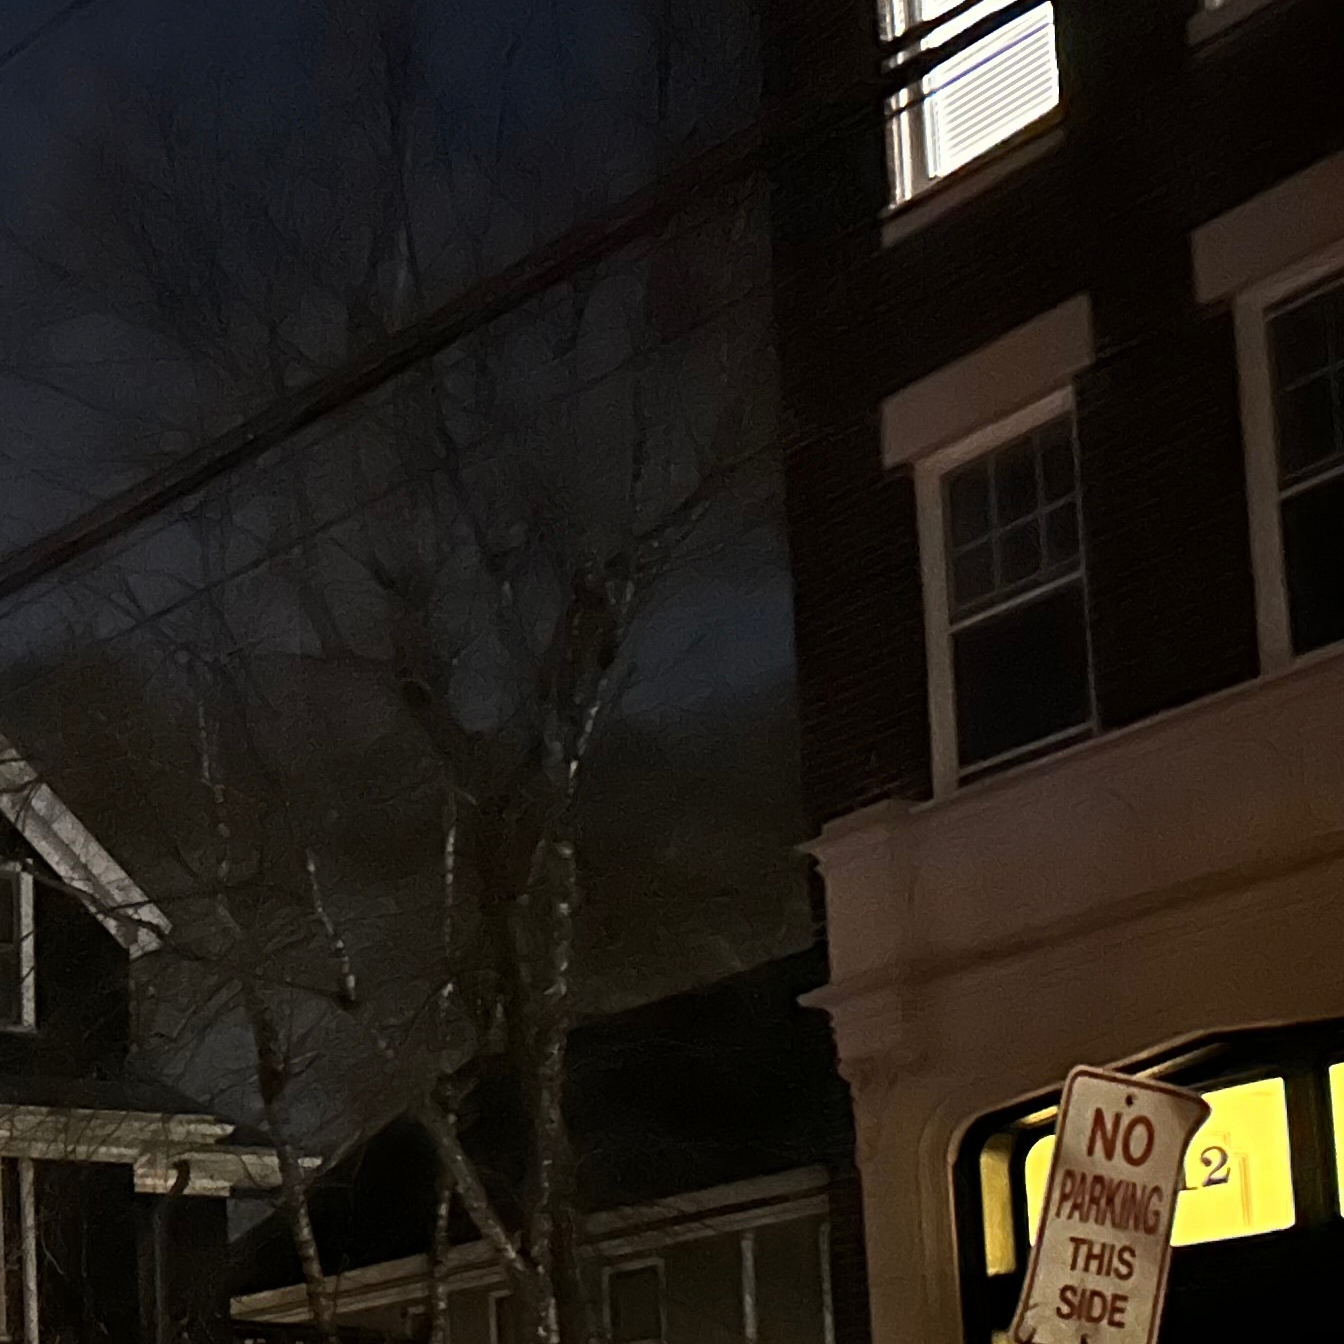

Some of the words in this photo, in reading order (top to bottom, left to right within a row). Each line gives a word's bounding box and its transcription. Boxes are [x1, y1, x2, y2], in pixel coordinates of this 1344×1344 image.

[1087, 1107, 1155, 1167] NO
[1054, 1168, 1163, 1236] PARKING
[1069, 1236, 1137, 1281] THIS
[1055, 1284, 1129, 1330] SIDE
